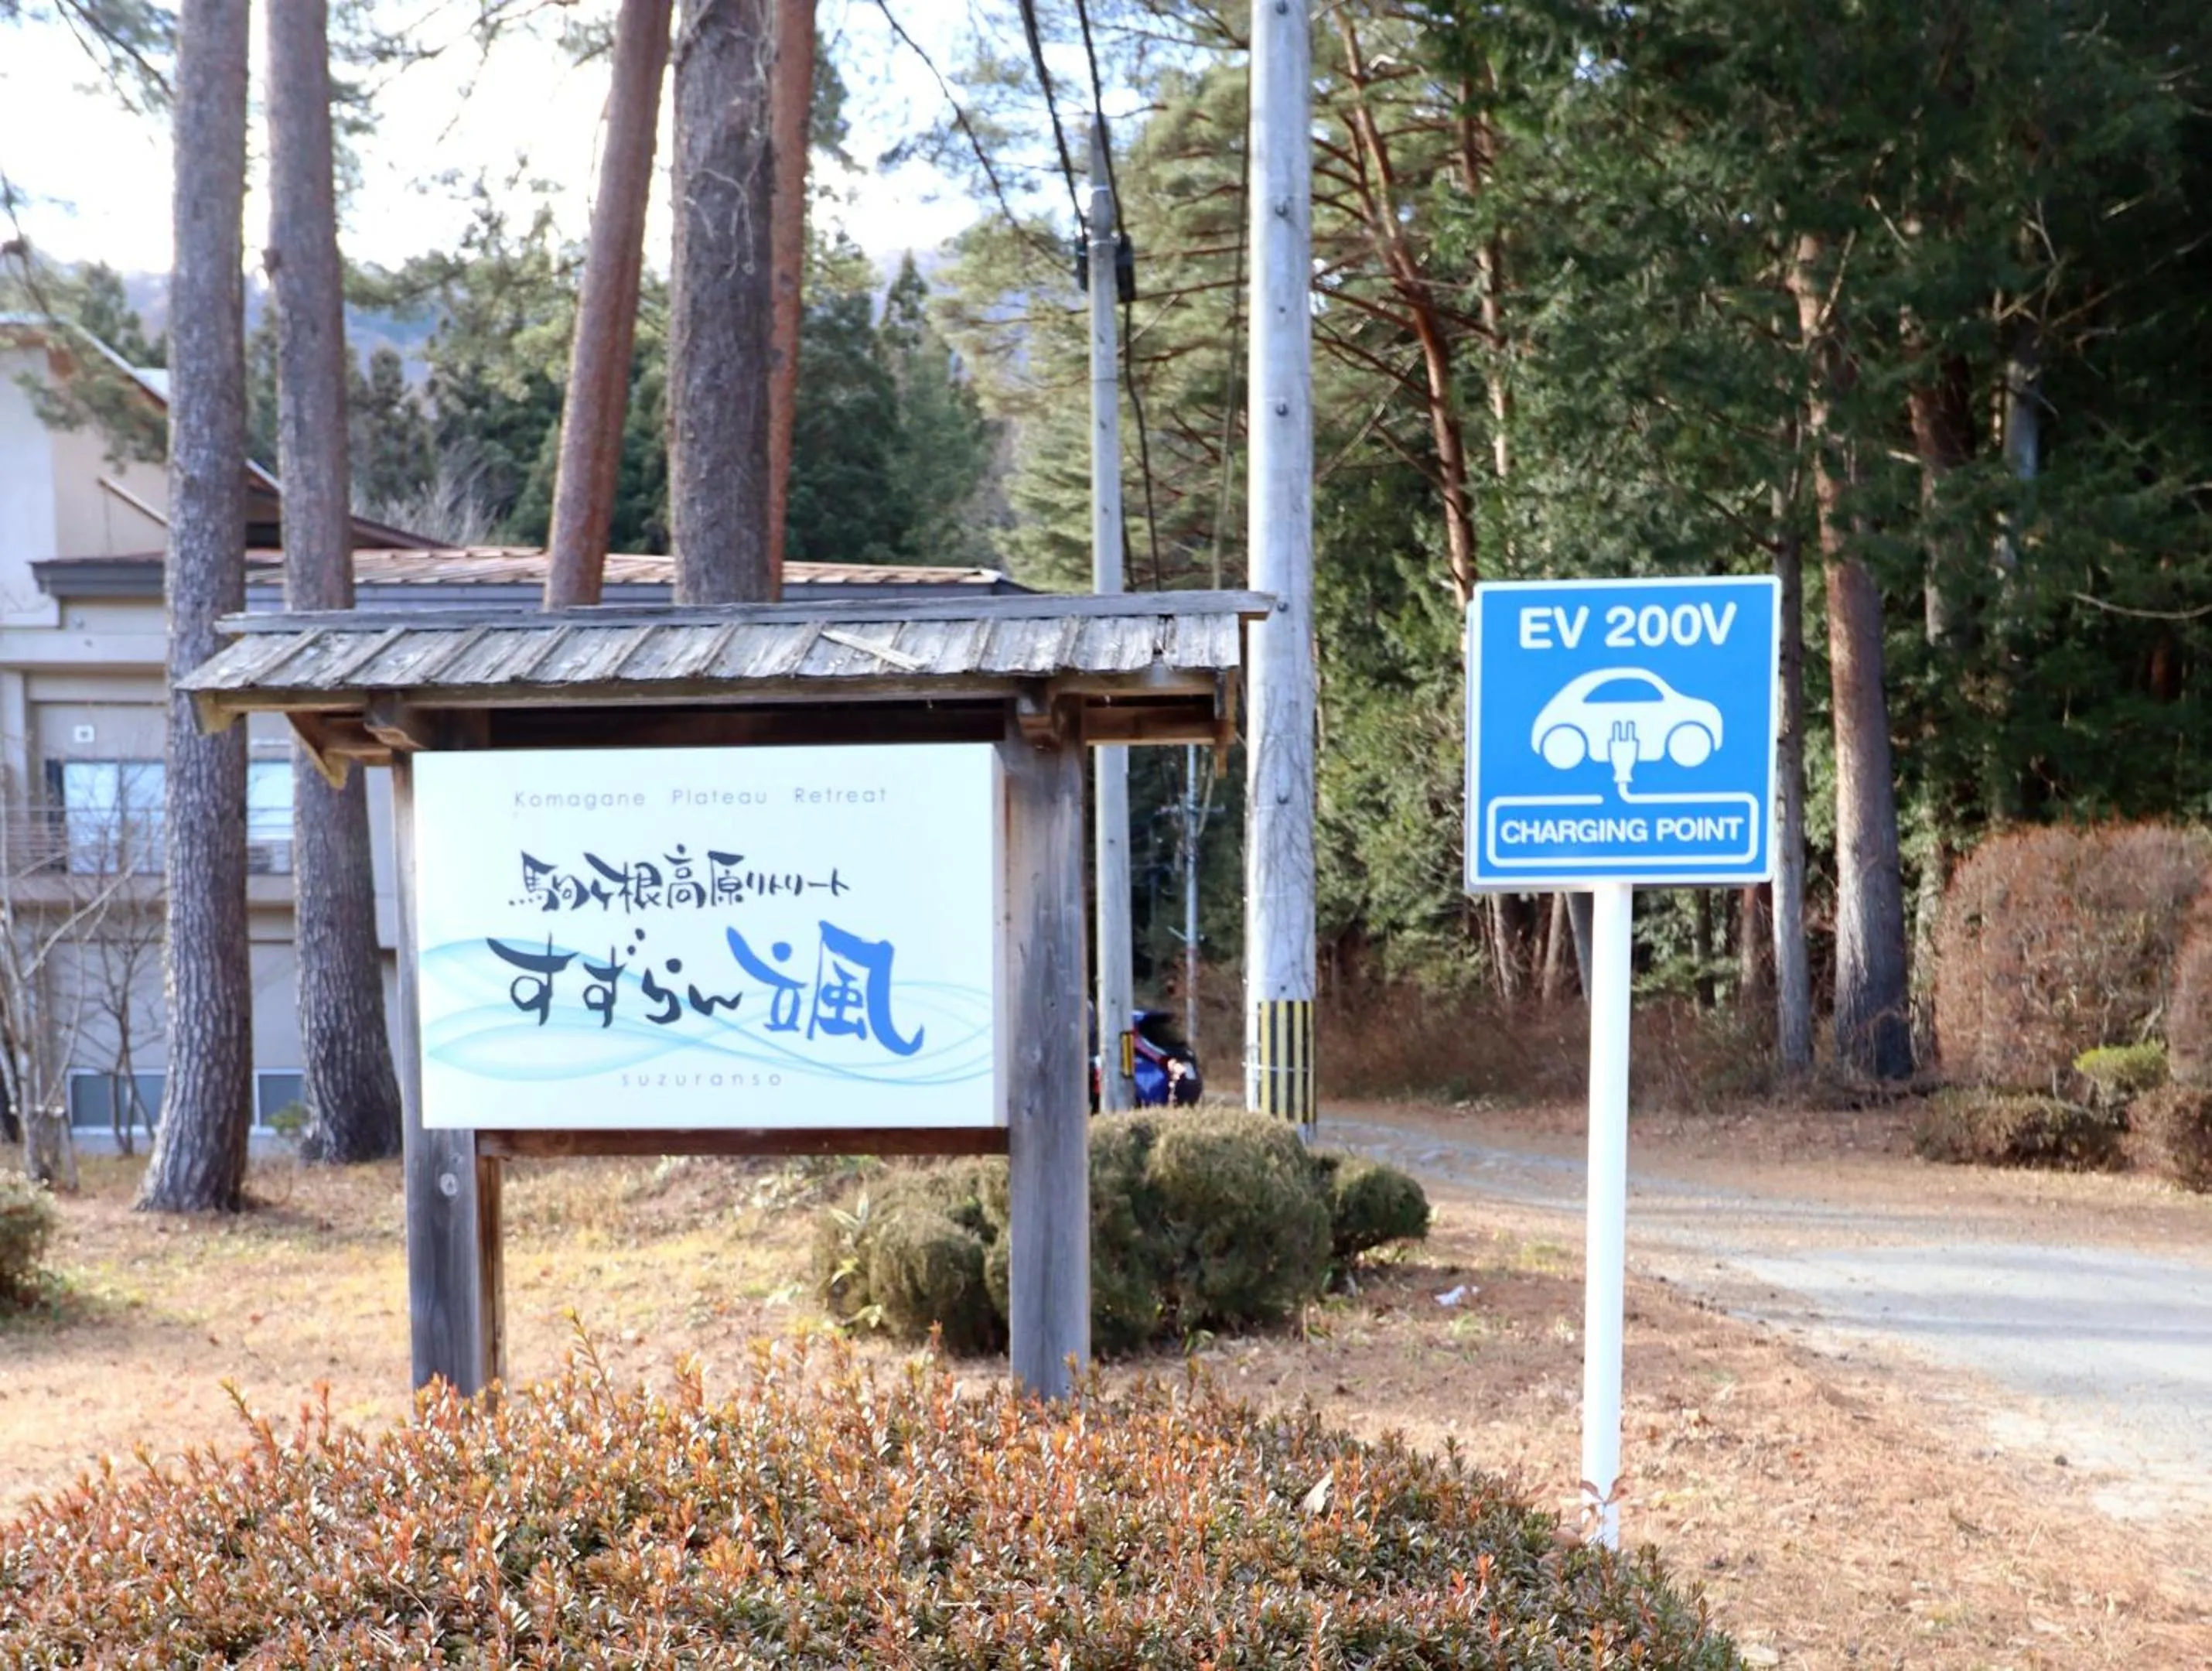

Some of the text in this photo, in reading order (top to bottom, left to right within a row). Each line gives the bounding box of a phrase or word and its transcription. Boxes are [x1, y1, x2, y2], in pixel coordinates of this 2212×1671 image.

[1519, 602, 1737, 649] EV 200V
[514, 786, 887, 811] Komagane Plateau Retreat
[1500, 816, 1744, 845] CHARGING POINT
[621, 1072, 782, 1087] suzuranso
